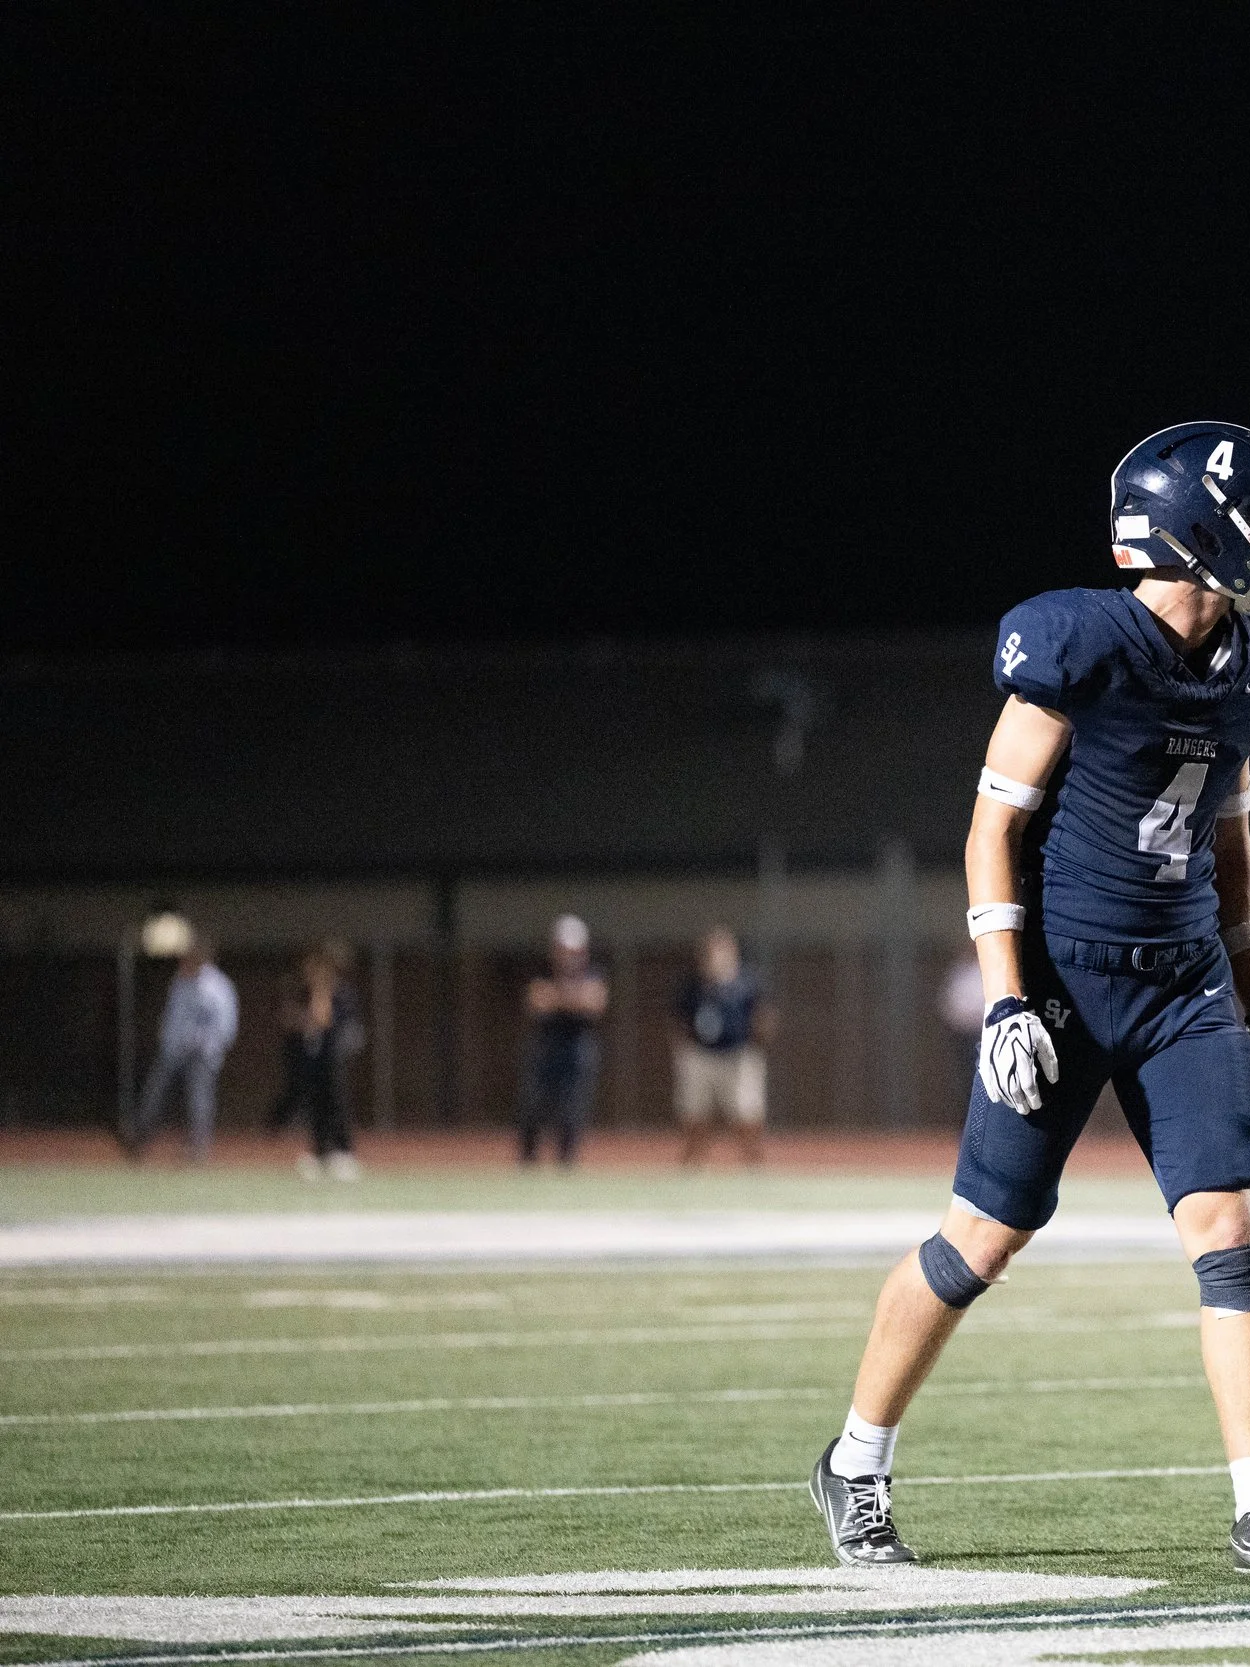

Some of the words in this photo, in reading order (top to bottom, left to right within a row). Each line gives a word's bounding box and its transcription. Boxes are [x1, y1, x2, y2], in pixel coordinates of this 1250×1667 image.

[1206, 440, 1234, 480] 4
[1000, 631, 1028, 678] SV
[1165, 737, 1219, 758] RANGERS
[1138, 762, 1209, 881] 4
[1044, 998, 1071, 1029] SV
